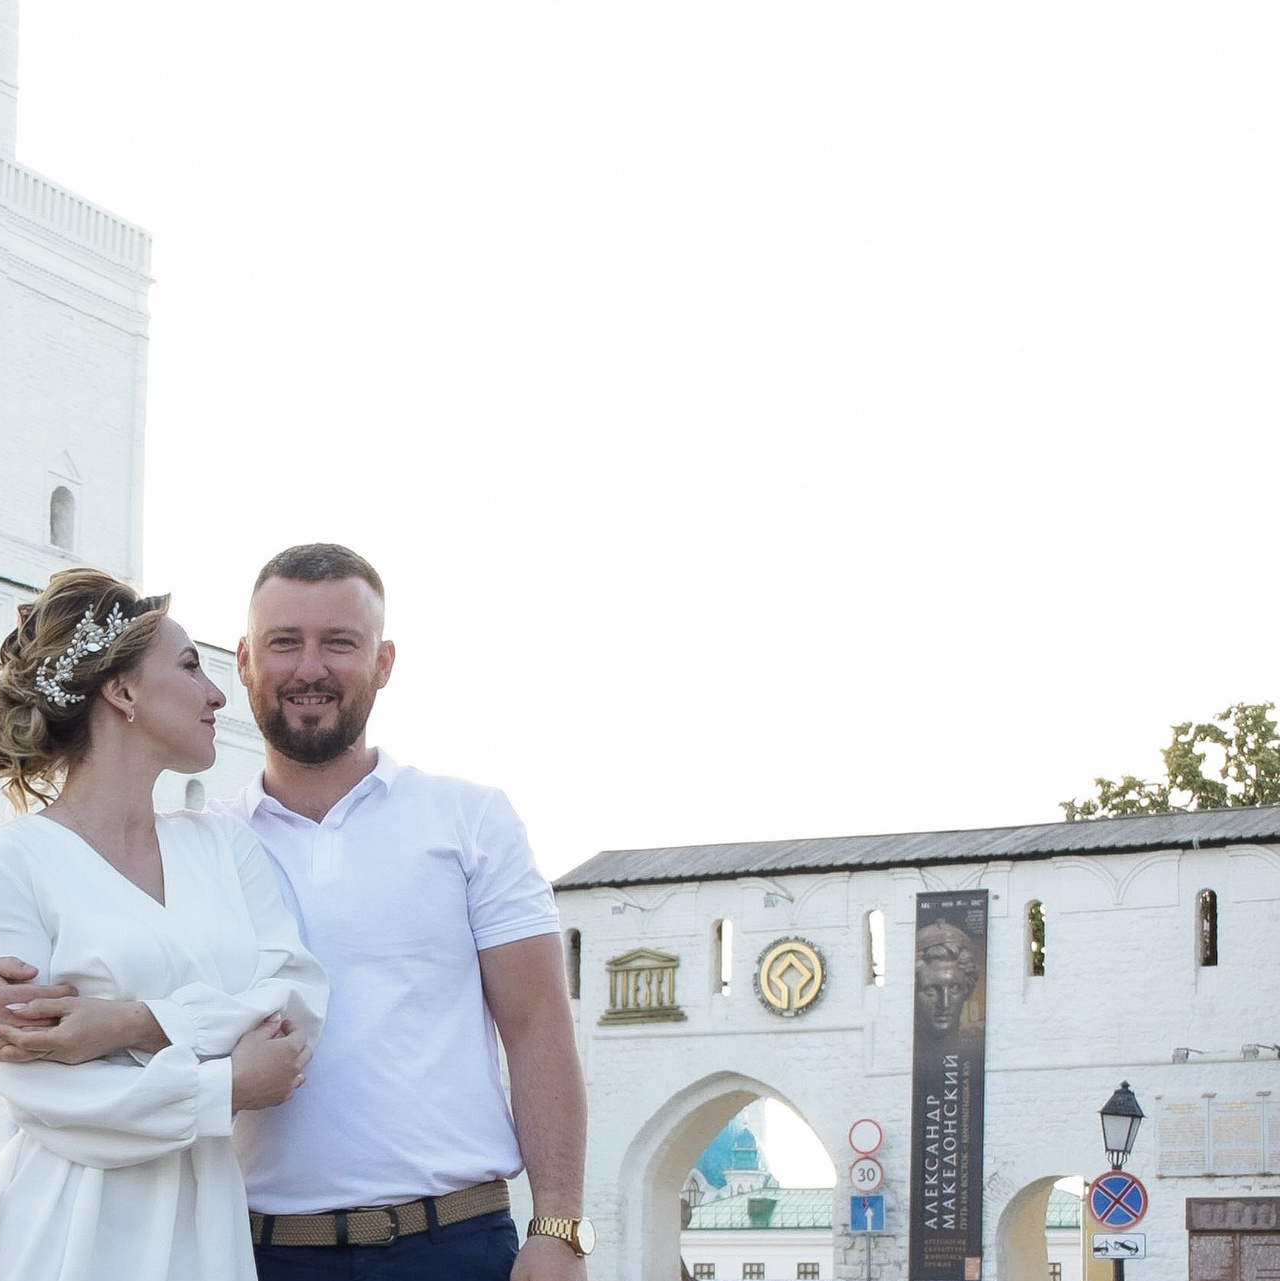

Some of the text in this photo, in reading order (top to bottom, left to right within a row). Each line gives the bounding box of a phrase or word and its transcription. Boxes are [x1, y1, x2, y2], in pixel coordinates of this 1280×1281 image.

[857, 1167, 876, 1183] 30
[924, 1094, 941, 1230] АЛЕКСАНДР
[942, 1054, 959, 1230] МАКЕДОНСКИЙ
